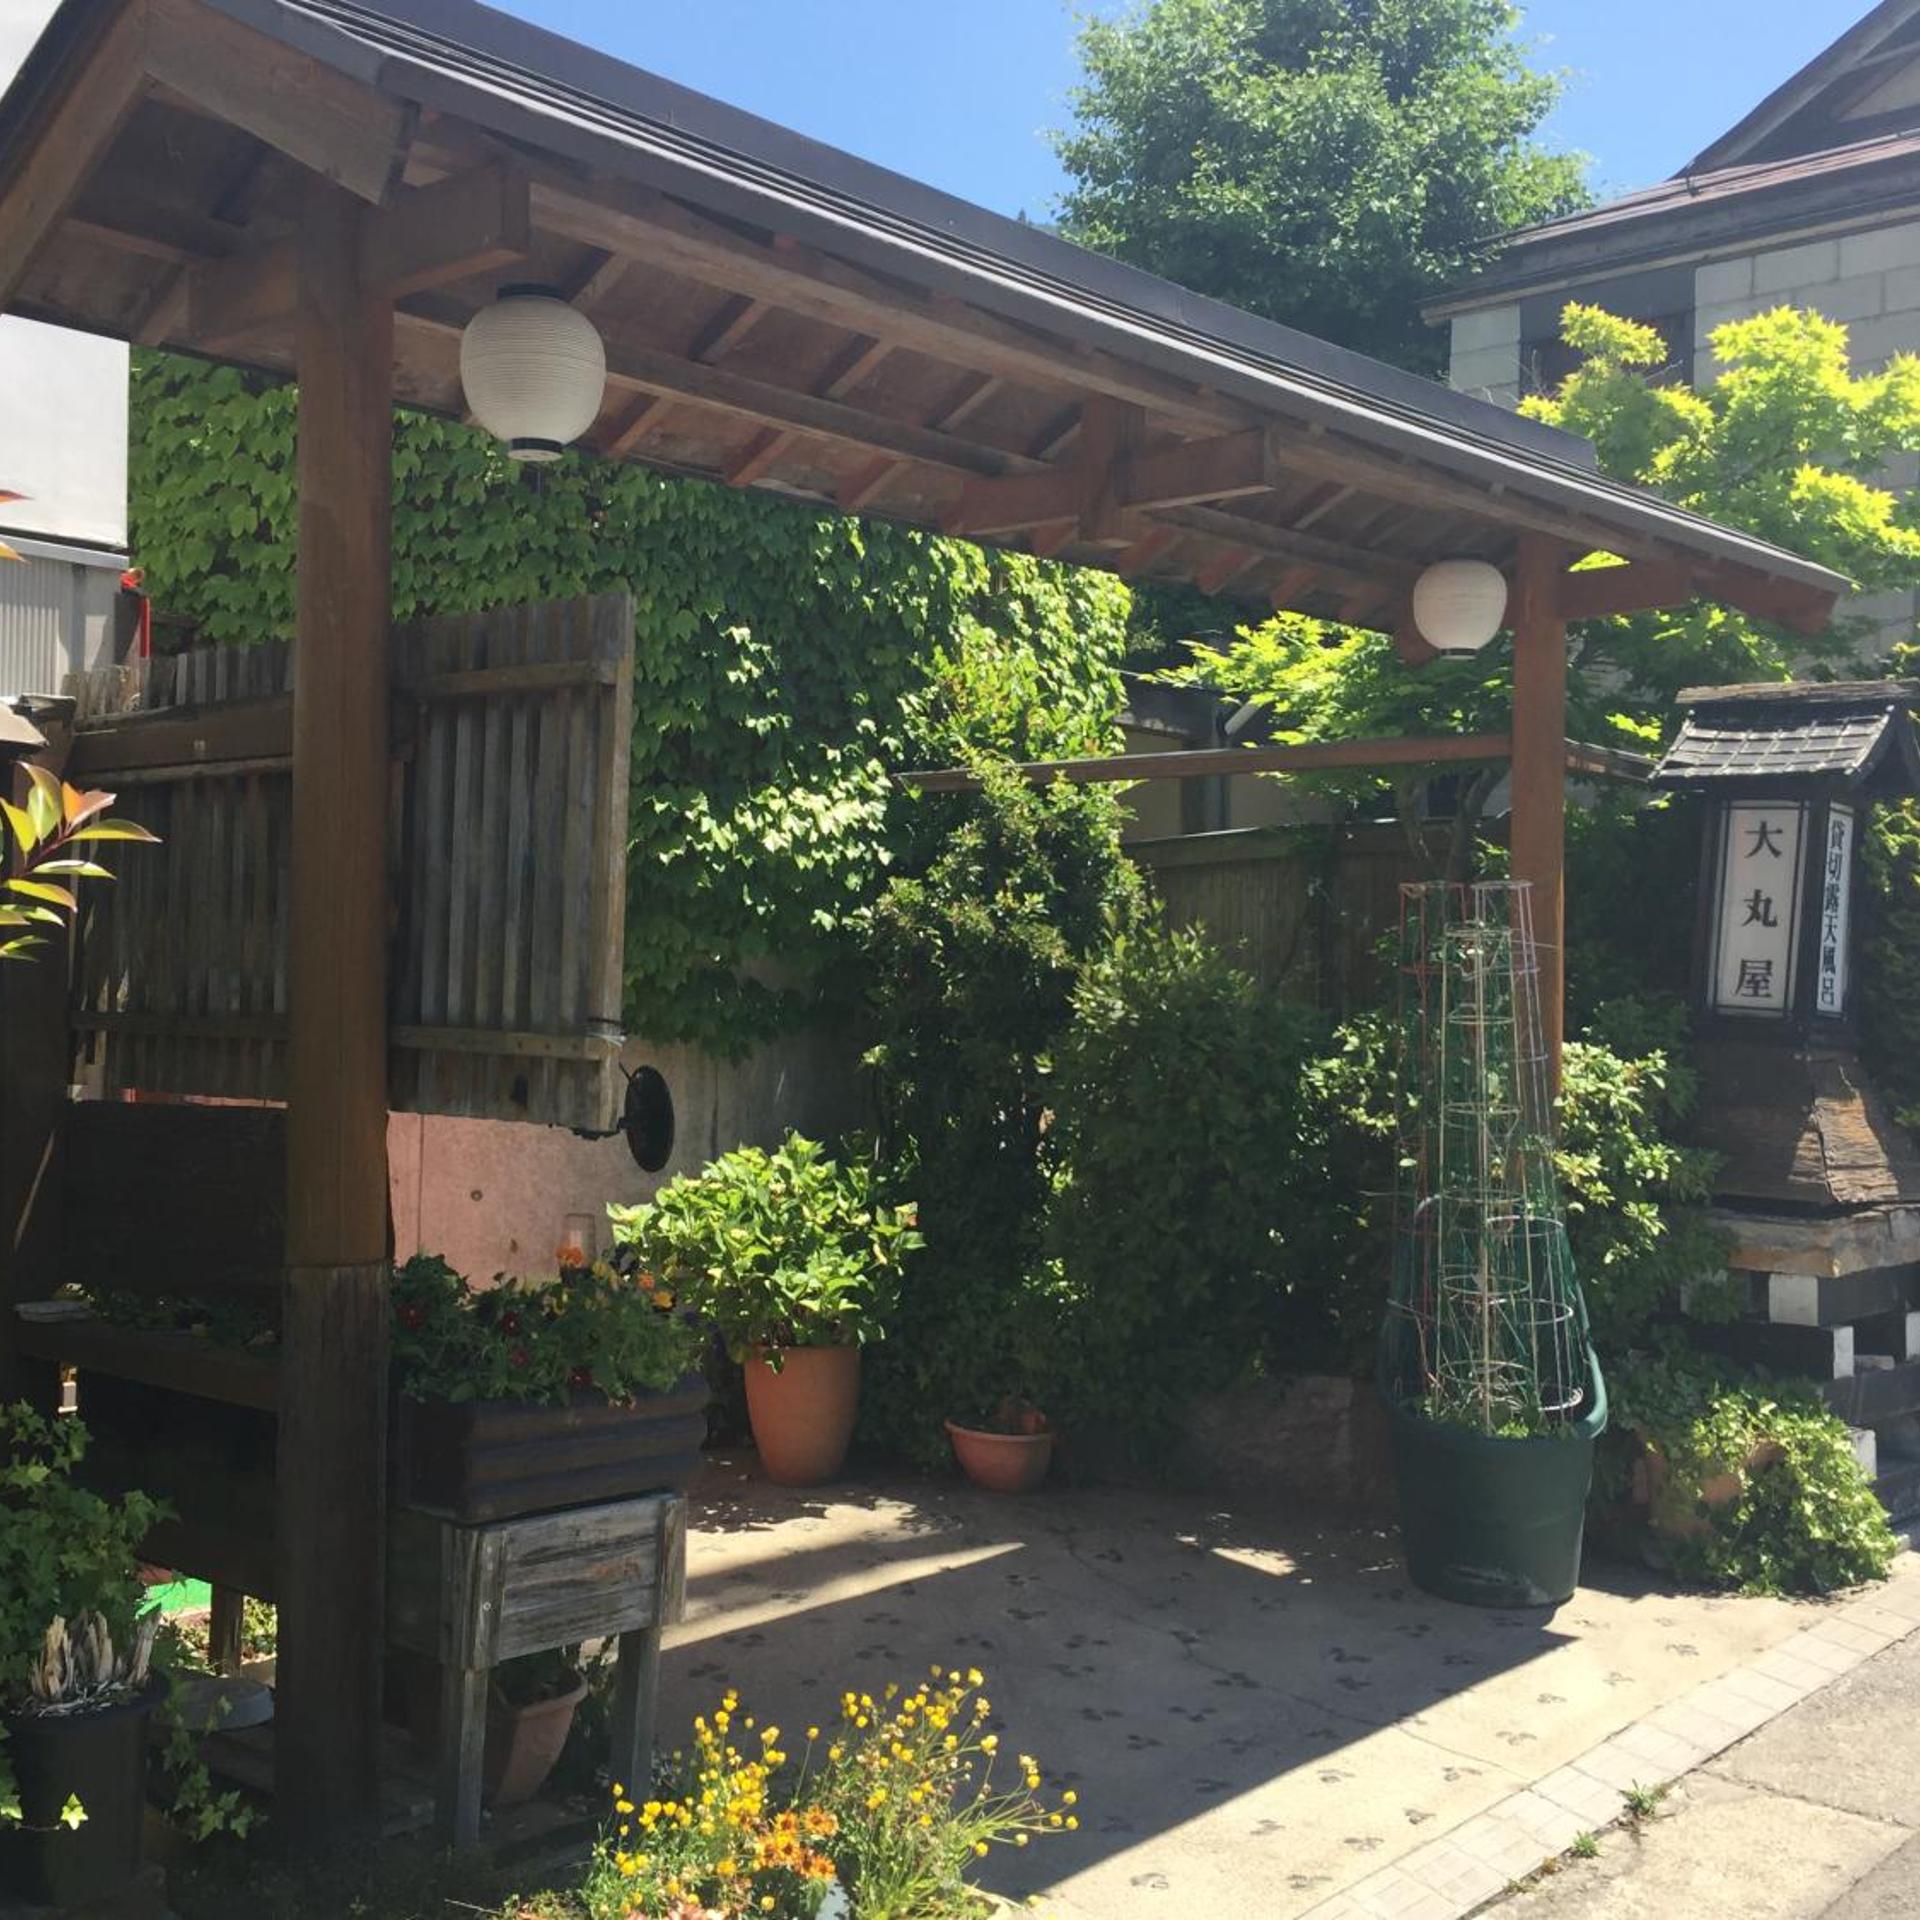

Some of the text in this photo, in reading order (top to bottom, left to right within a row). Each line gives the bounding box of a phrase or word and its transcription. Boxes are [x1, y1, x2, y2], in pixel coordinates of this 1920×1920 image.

[1733, 821, 1783, 998] 大丸屋
[1821, 819, 1845, 1006] 貸切露天風呂
